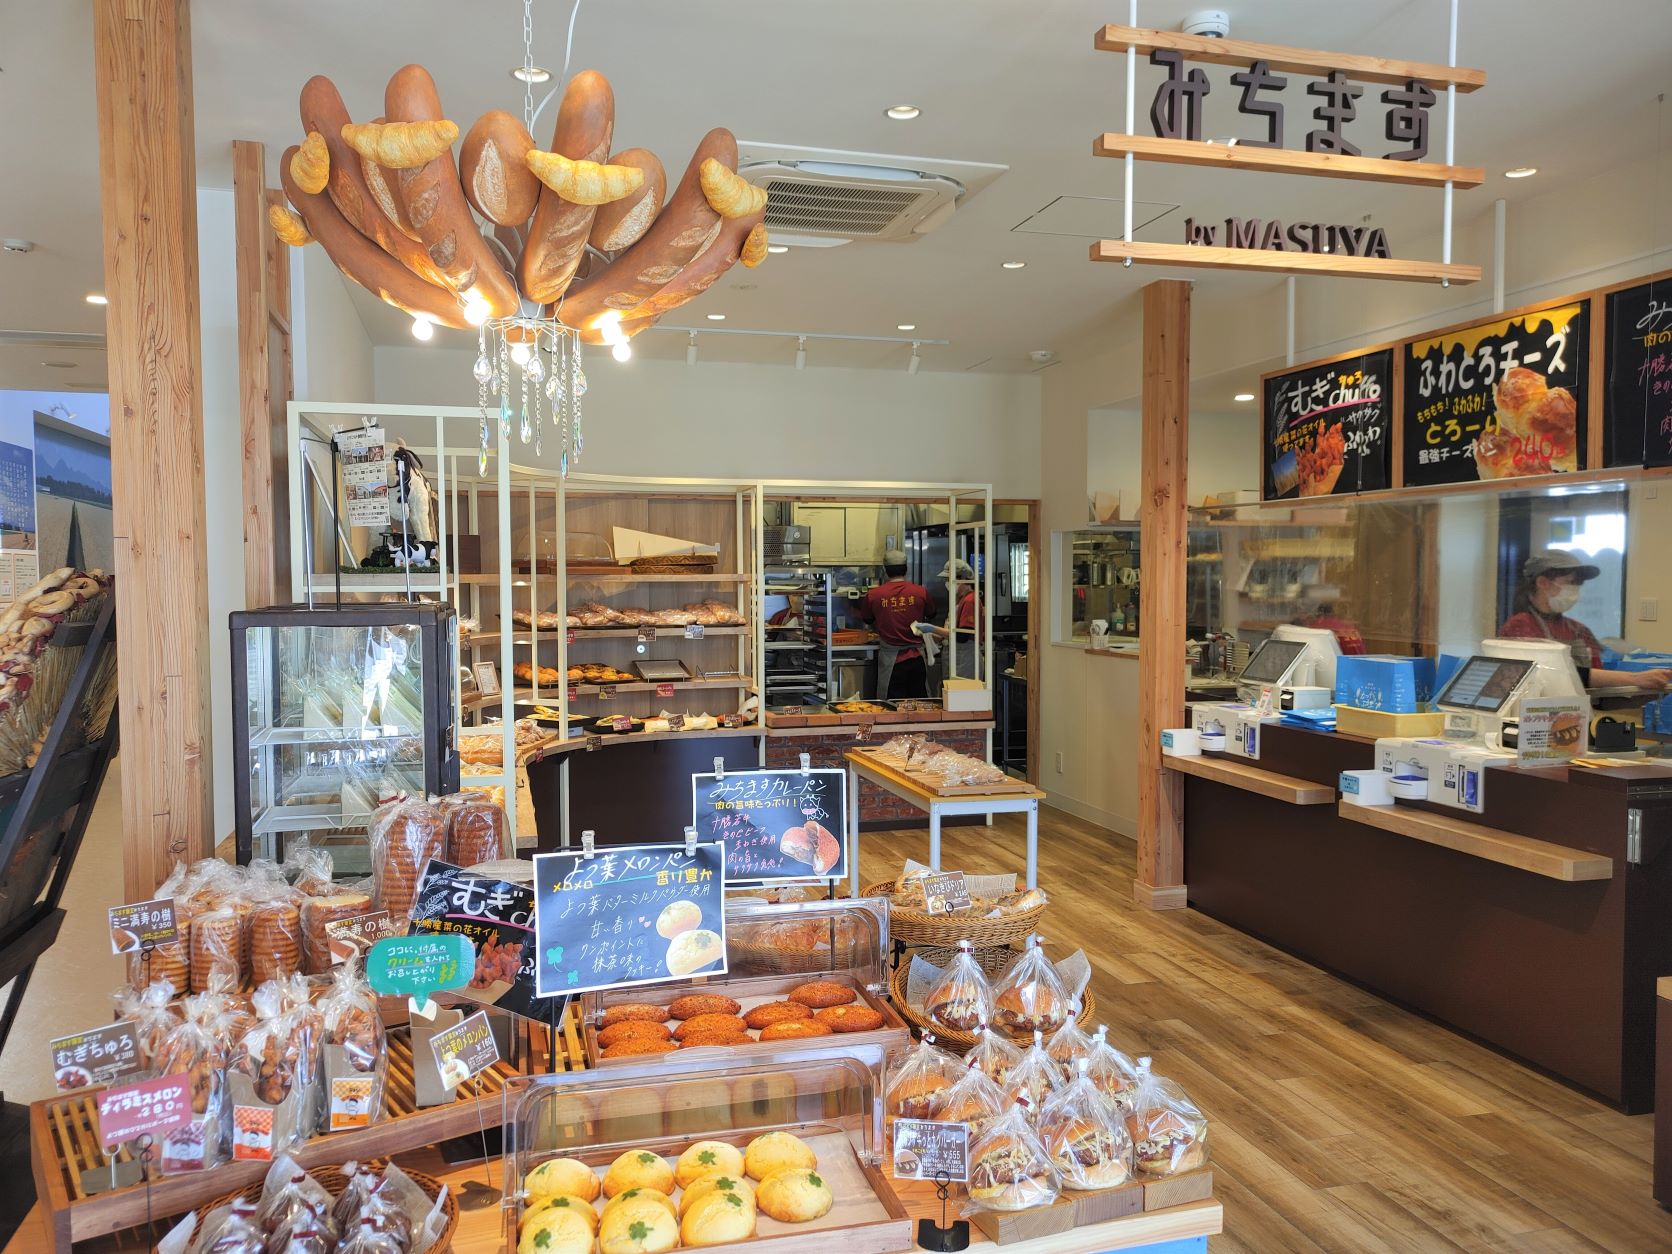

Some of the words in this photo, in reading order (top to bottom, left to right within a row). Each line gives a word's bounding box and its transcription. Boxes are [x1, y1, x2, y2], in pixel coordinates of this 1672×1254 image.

[1150, 50, 1436, 161] みちます
[1184, 217, 1218, 245] by
[1225, 217, 1392, 259] MASUYA
[1636, 300, 1672, 330] み
[1419, 325, 1570, 397] ふわとろチーズ
[1288, 371, 1335, 416] むぎ
[1426, 415, 1500, 445] とろーり
[710, 777, 827, 802] みちますカレーパン
[564, 852, 697, 881] よつ葉メロンパン
[656, 868, 713, 886] 香り豊か
[452, 879, 524, 921] むぎ
[560, 884, 711, 919] よつ葉バターミルクパウダー使用
[113, 907, 172, 929] ミニ満寿の樹
[580, 938, 644, 960] ワンポイントに
[56, 1034, 133, 1067] むぎちゅろ
[101, 1086, 182, 1116] ティラミスメロン
